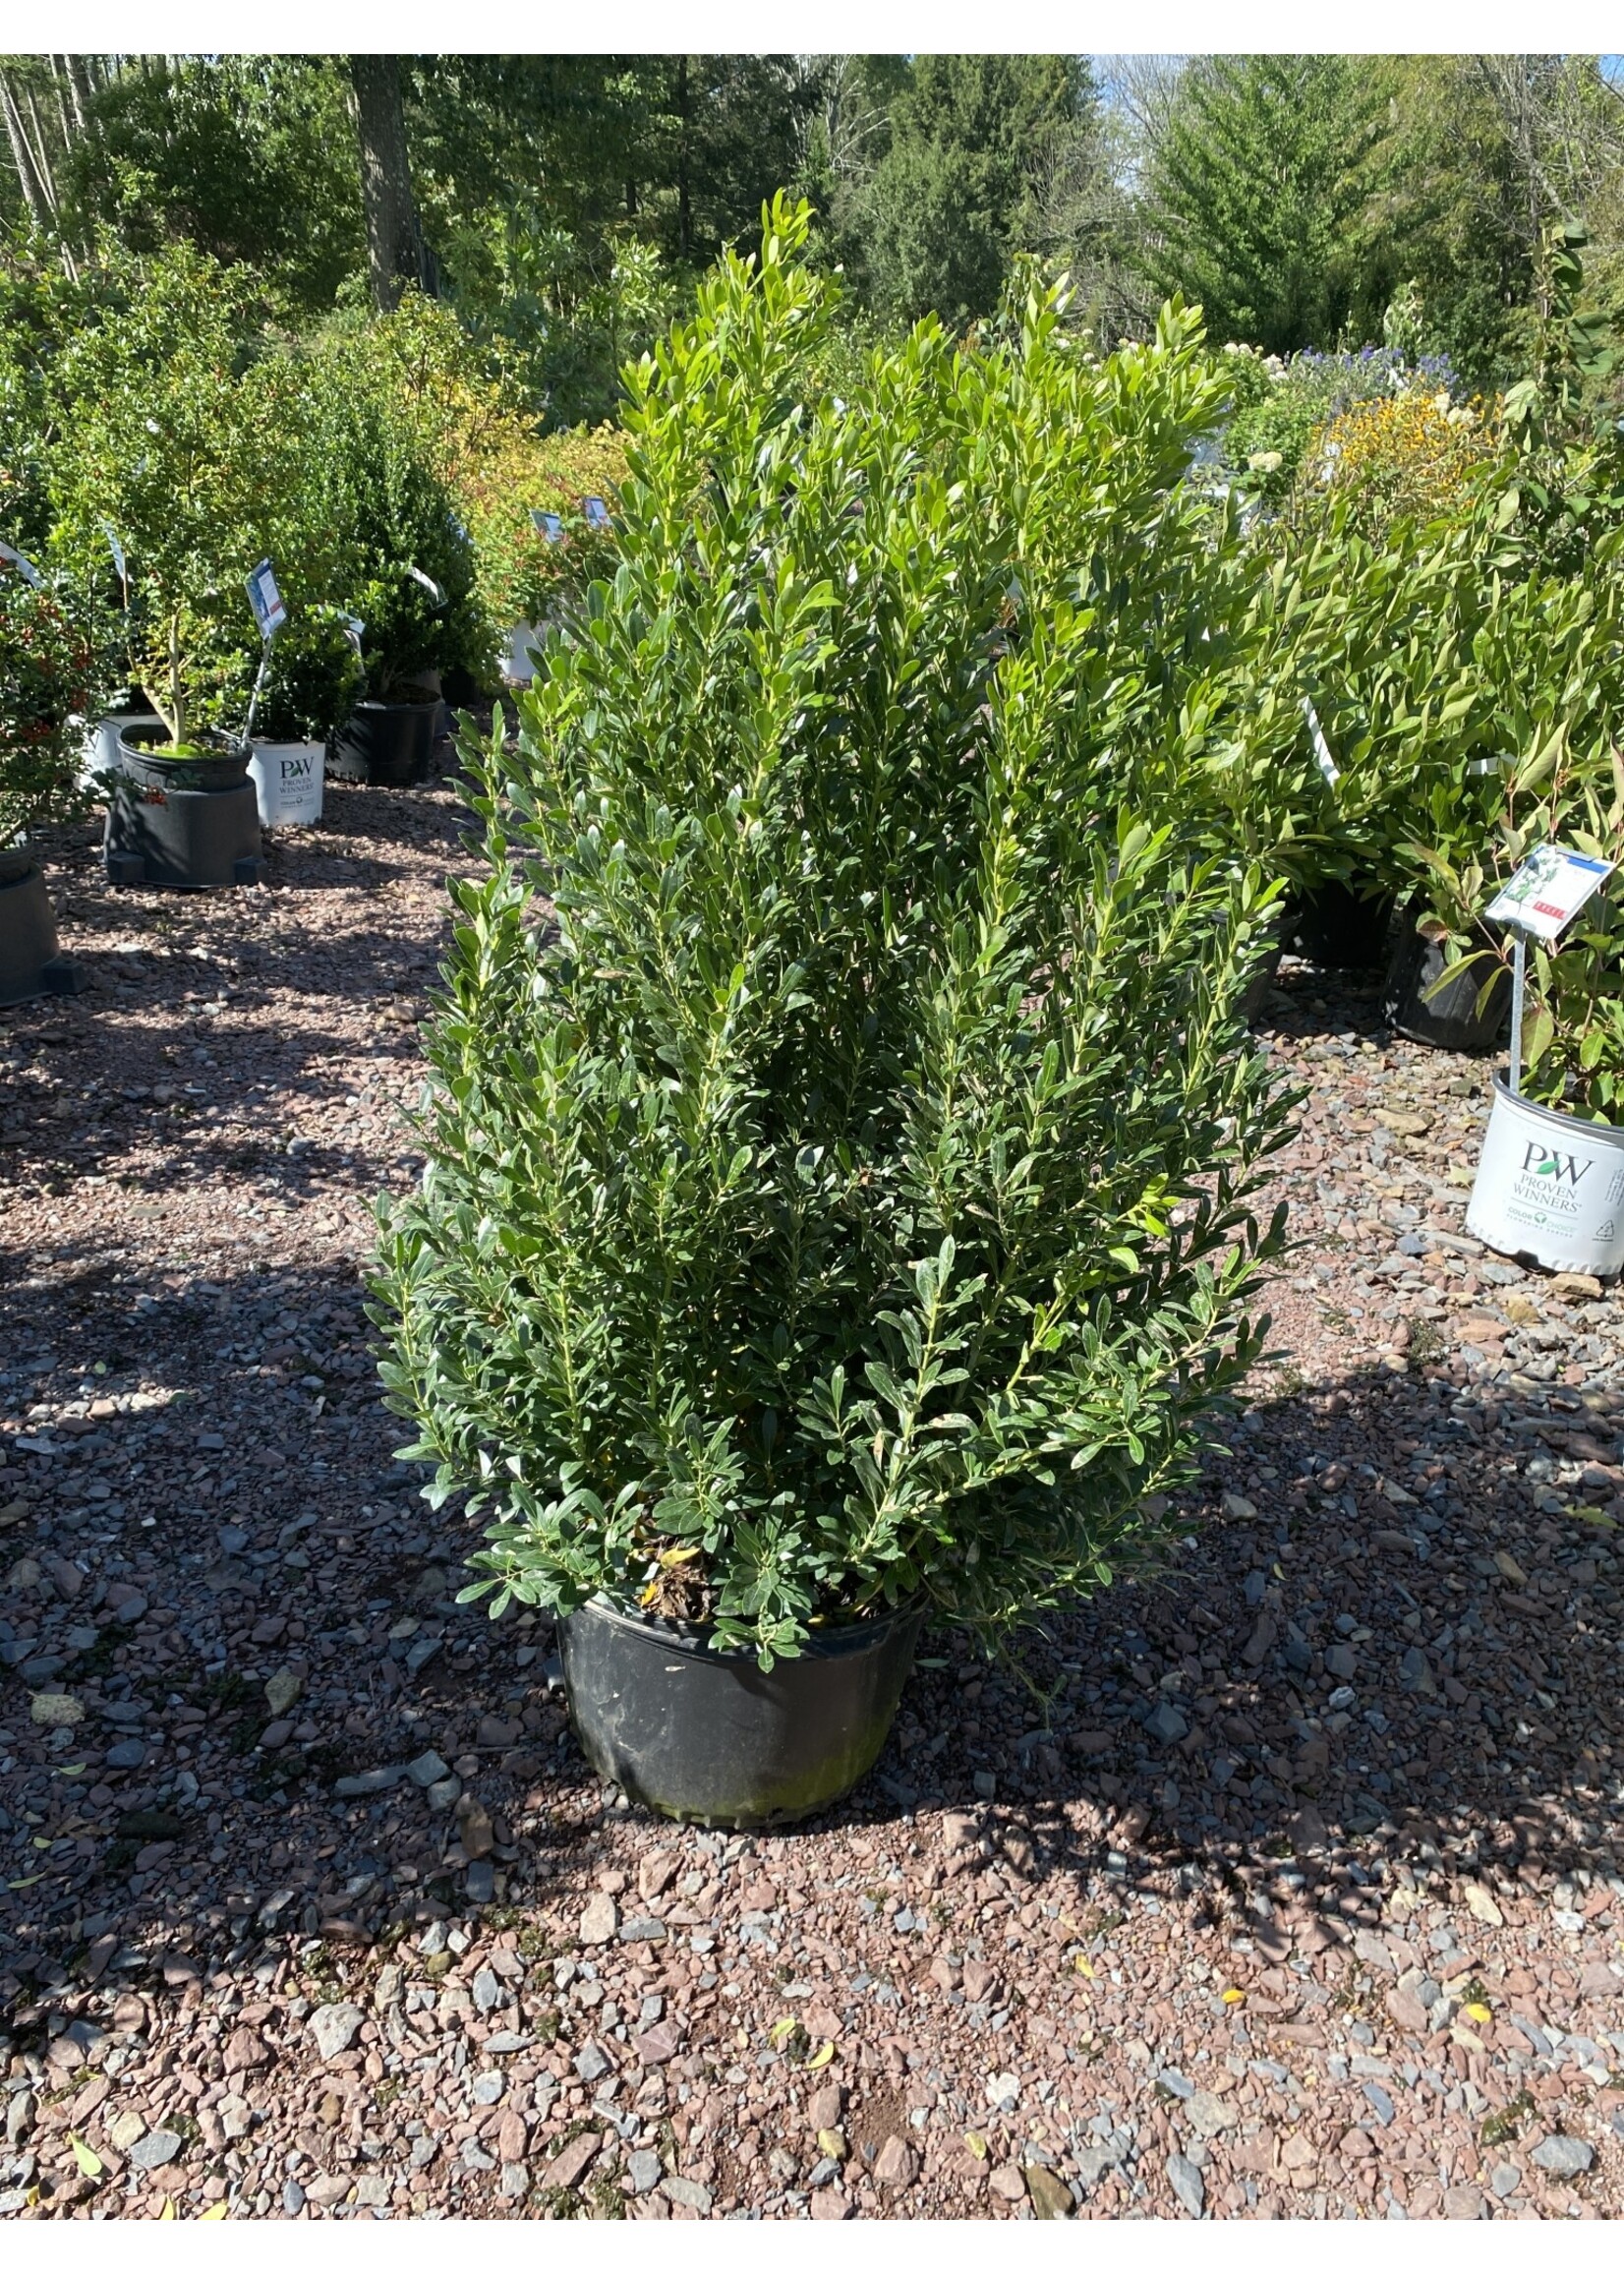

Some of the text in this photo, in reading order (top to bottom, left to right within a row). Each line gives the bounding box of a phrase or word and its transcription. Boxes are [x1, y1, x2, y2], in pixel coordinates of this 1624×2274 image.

[280, 756, 315, 779] PW
[279, 783, 314, 794] WINNERS
[282, 777, 312, 787] PROVEN
[1520, 1139, 1596, 1187] PW
[1514, 1183, 1579, 1213] WINNERS
[1521, 1173, 1578, 1199] PROVEN
